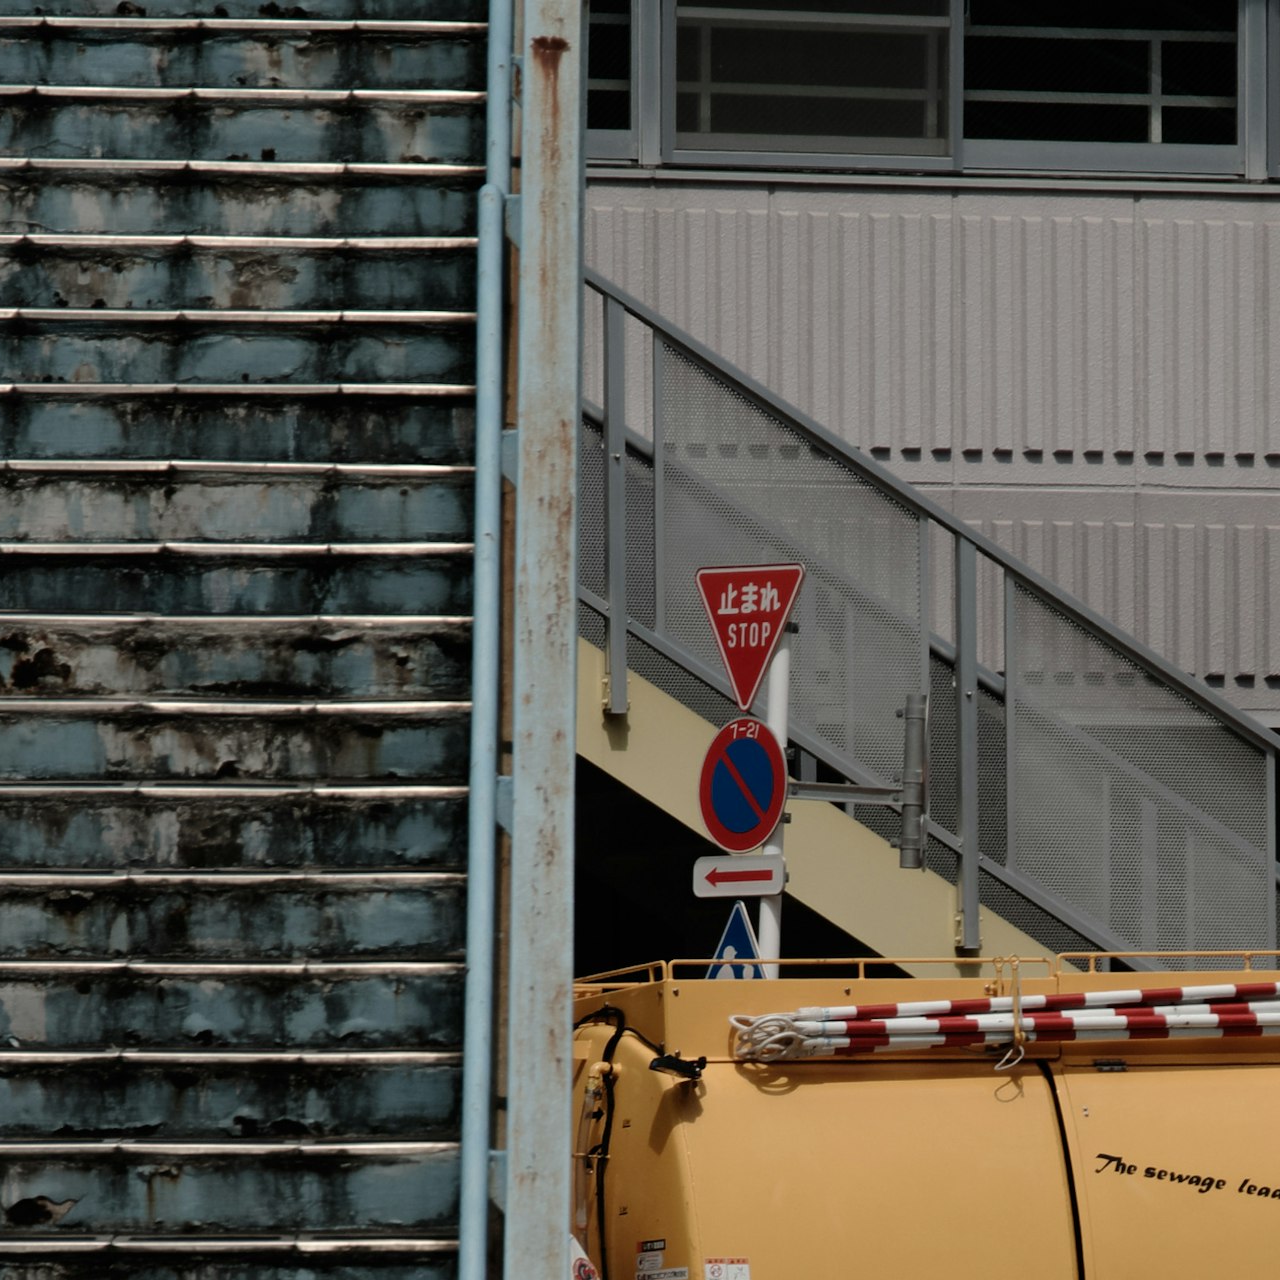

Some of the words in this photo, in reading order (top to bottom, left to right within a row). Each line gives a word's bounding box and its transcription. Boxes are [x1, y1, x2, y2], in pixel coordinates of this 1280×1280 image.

[717, 581, 781, 615] 止まれ
[727, 622, 771, 648] STOP
[729, 721, 760, 739] 7-21
[1095, 1153, 1138, 1175] The
[1143, 1166, 1227, 1194] sewage
